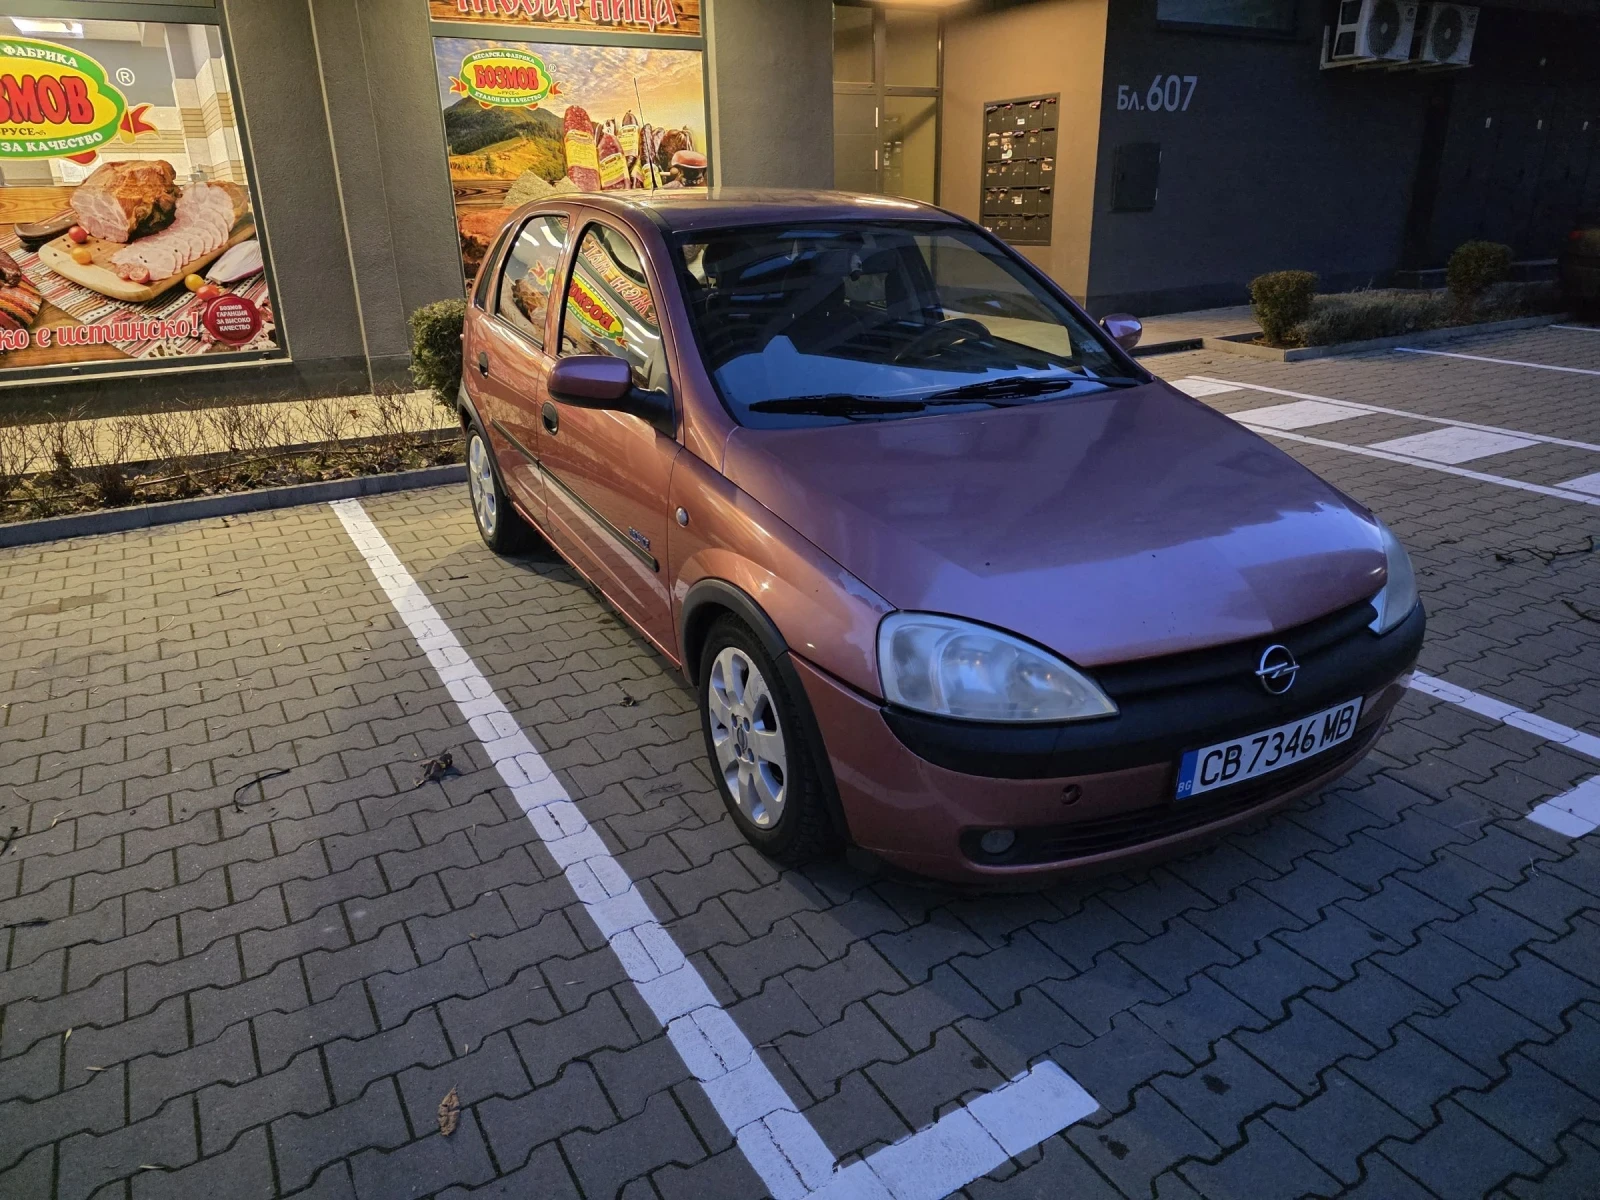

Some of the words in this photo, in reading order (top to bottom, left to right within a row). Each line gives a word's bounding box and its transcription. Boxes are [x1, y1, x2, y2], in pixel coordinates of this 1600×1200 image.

[3, 45, 79, 68] ФАБРИКА
[472, 51, 505, 60] МЕСАРСКА
[505, 53, 535, 63] ФАБРИКА
[474, 65, 539, 90] БОЗМОВ
[1, 127, 36, 136] РУСЕ
[1, 142, 23, 152] ЗА
[26, 132, 103, 152] КАЧЕСТВО
[36, 327, 51, 347] е
[57, 312, 199, 347] истинско!
[1200, 745, 1242, 786] CB
[1247, 720, 1316, 773] 7346
[1320, 705, 1354, 747] MB
[1178, 780, 1192, 792] BG
